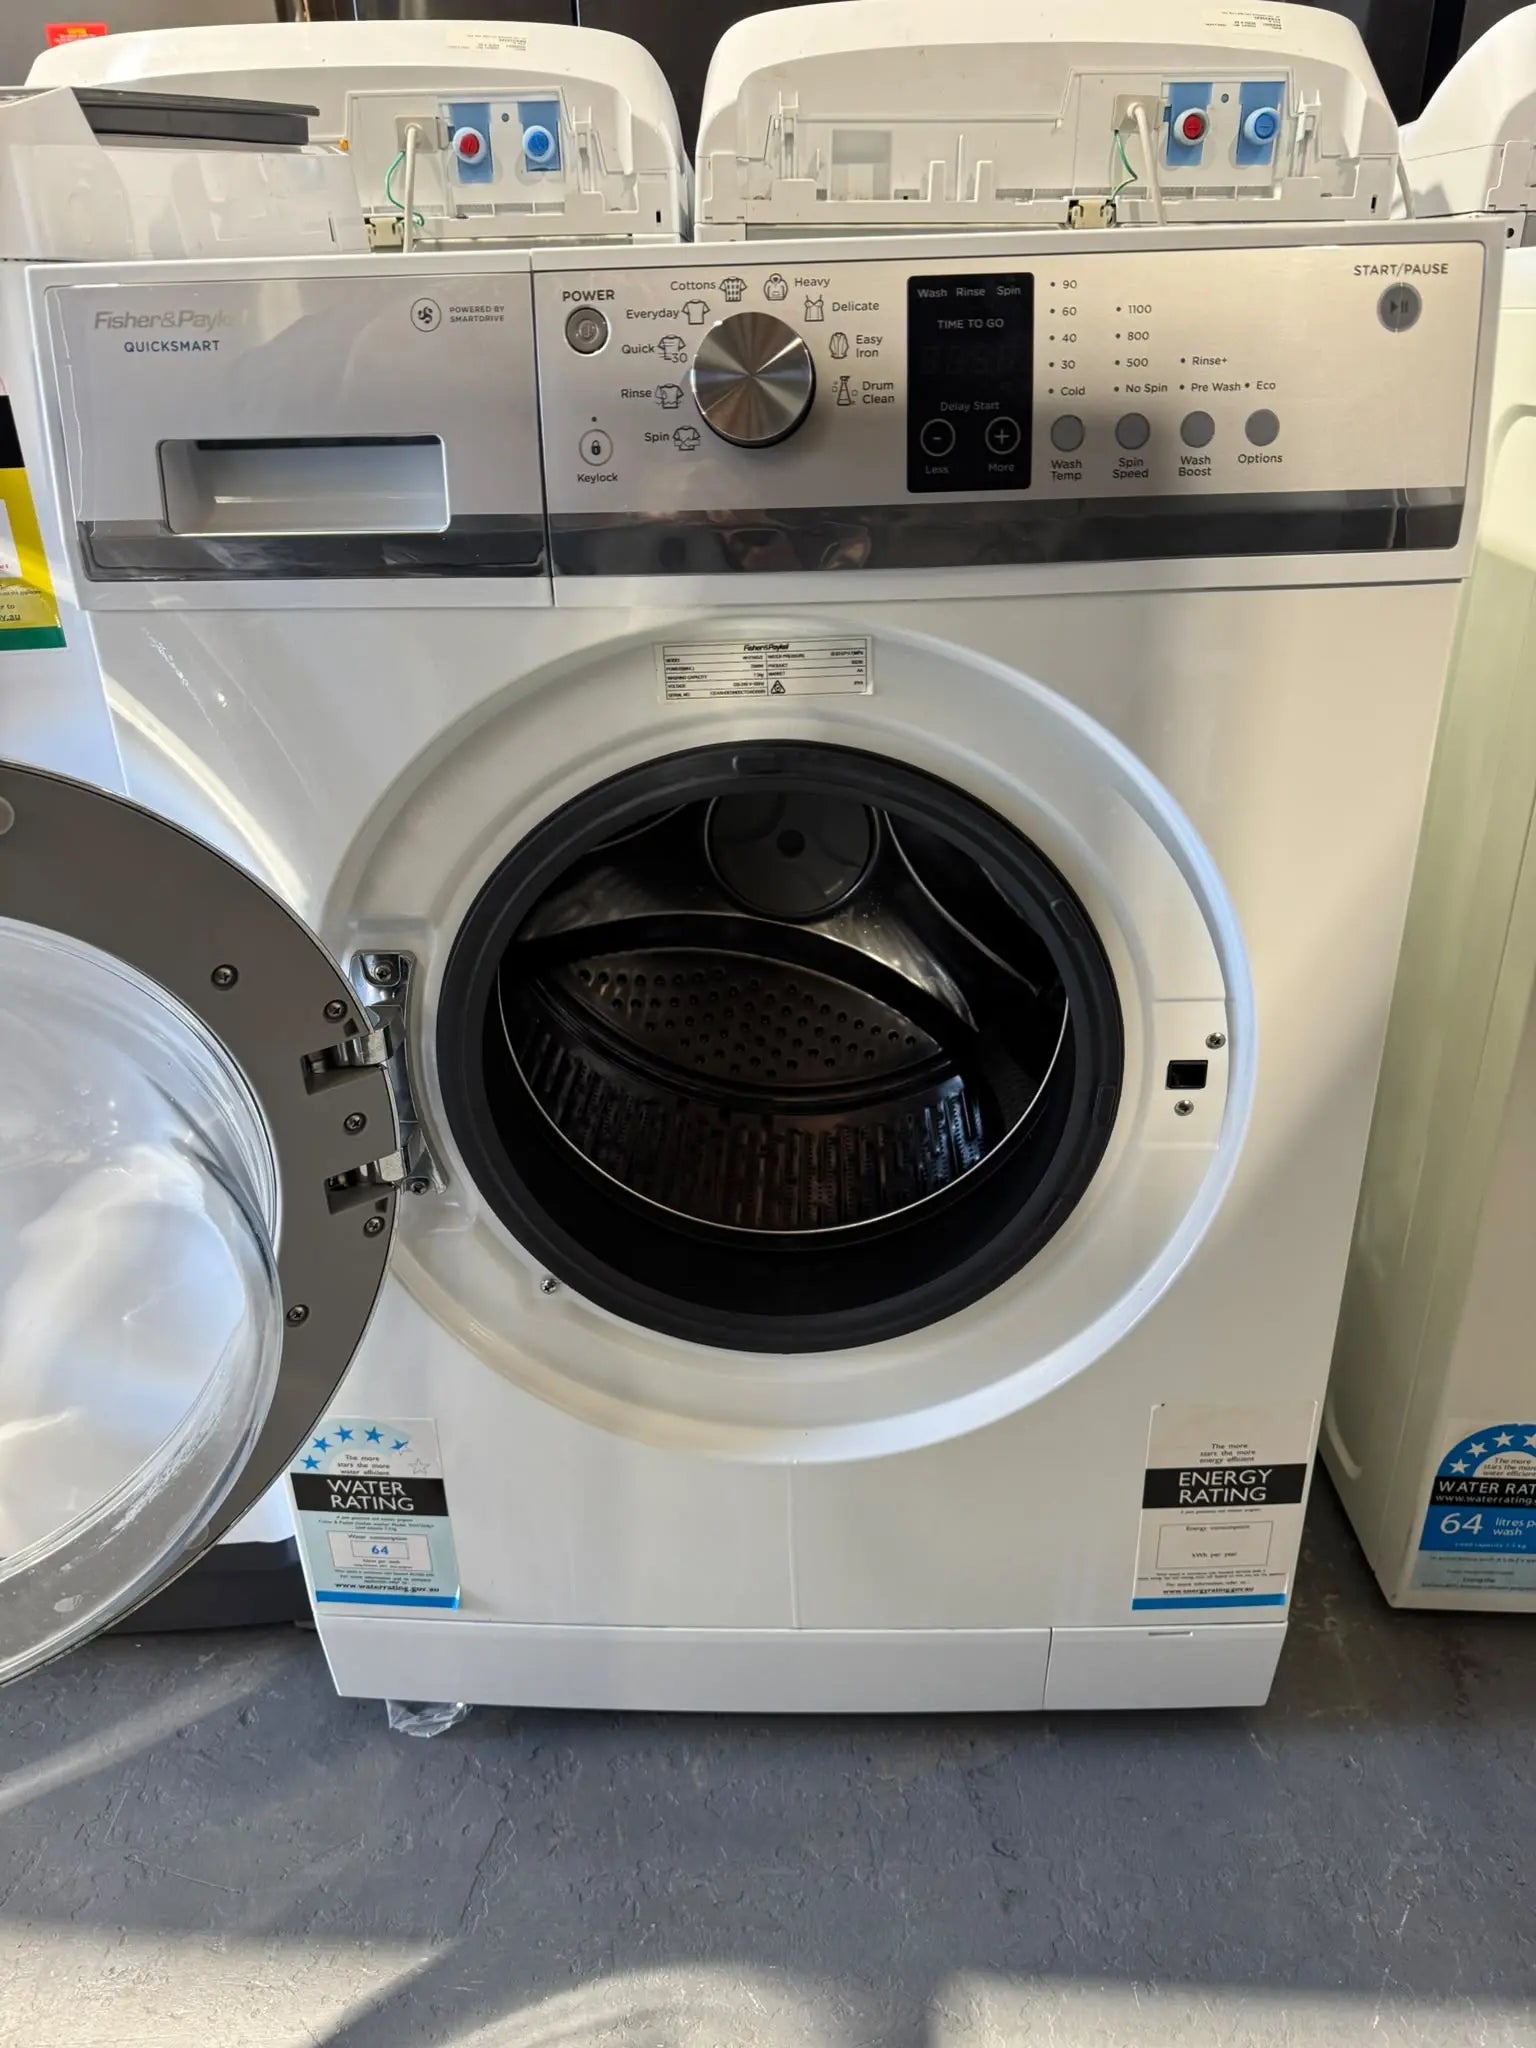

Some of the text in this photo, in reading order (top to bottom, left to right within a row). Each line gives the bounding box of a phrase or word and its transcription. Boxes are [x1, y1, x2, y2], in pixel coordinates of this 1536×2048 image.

[1353, 263, 1449, 277] START/PAUSE
[670, 280, 717, 291] Cottons
[794, 276, 831, 288] Heavy
[1062, 279, 1078, 289] 90
[562, 289, 615, 301] POWER
[917, 284, 1022, 298] Wash Rinse Spin
[449, 305, 492, 313] POWERED
[832, 301, 880, 312] Delicate
[1062, 306, 1078, 316] 60
[1128, 304, 1153, 314] 1100
[450, 315, 505, 323] SMARTDRIVE
[625, 308, 680, 321] Everyday
[937, 318, 1005, 329] TIME TO GO
[856, 335, 884, 347] Easy
[1062, 333, 1078, 343] 40
[1127, 331, 1150, 341] 800
[124, 340, 220, 352] QUICKSMART
[621, 343, 655, 355] Quick
[671, 352, 688, 363] 30
[856, 348, 879, 358] Iron
[1061, 360, 1076, 370] 30
[1126, 358, 1149, 368] 500
[1192, 355, 1228, 366] Rinse+
[862, 380, 895, 391] Drum
[1060, 386, 1086, 396] Cold
[1125, 382, 1169, 395] No Spin
[1191, 382, 1241, 393] Pre Wash
[1256, 381, 1277, 391] Eco
[621, 388, 653, 399] Rinse
[862, 393, 896, 404] Clean
[940, 400, 1000, 413] Delay Start
[644, 432, 670, 444] Spin
[1051, 459, 1083, 470] Wash
[1118, 457, 1145, 470] Spin
[1180, 455, 1212, 466] Wash
[1237, 453, 1283, 466] Options
[925, 465, 950, 476] Less
[988, 462, 1015, 473] More
[1178, 466, 1212, 477] Boost
[577, 472, 618, 484] Keylock
[1051, 471, 1083, 483] Temp
[1112, 468, 1150, 480] Speed
[1179, 1469, 1273, 1487] ENERGY
[327, 1479, 406, 1496] WATER
[1439, 1481, 1500, 1494] WATER
[1179, 1487, 1267, 1504] RATING
[330, 1495, 415, 1511] RATING
[1440, 1512, 1484, 1536] 64
[1495, 1517, 1524, 1527] litres
[1493, 1527, 1522, 1537] wash
[371, 1545, 389, 1555] 64
